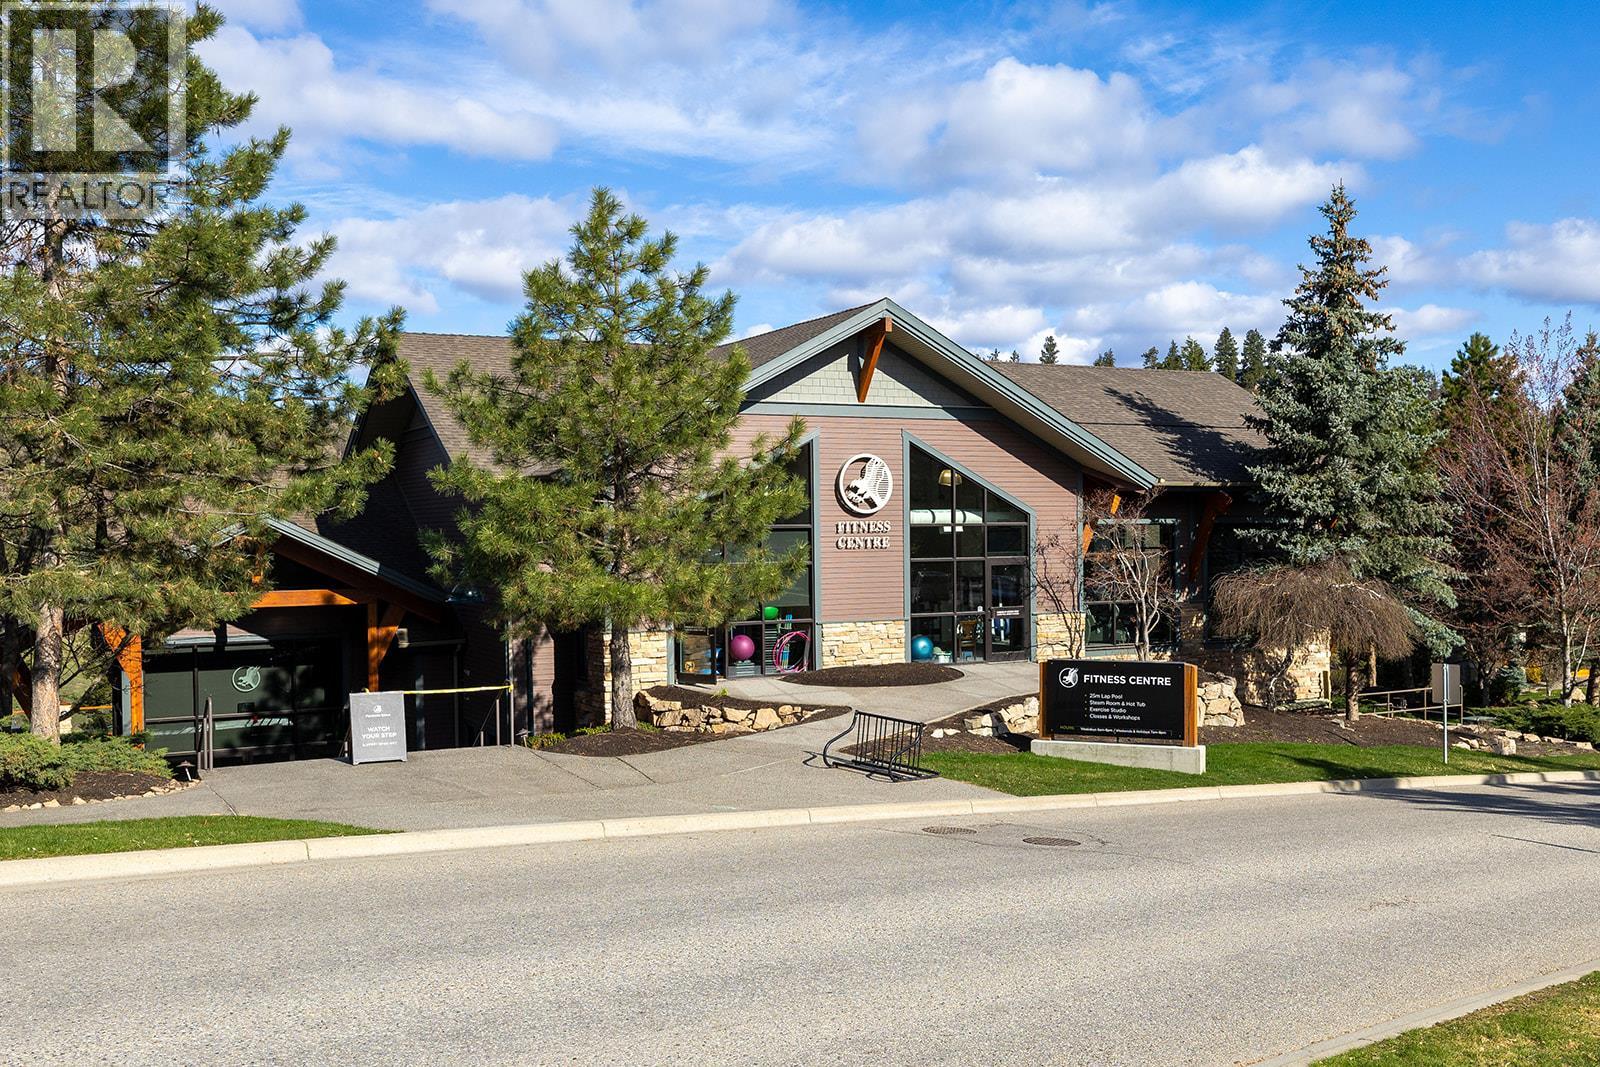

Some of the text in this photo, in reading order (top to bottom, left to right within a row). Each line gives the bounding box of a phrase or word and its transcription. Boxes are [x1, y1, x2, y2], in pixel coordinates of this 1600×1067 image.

[836, 520, 891, 533] FITNESS
[836, 536, 890, 549] CENTRE
[1083, 674, 1171, 686] FITNESS CENTRE
